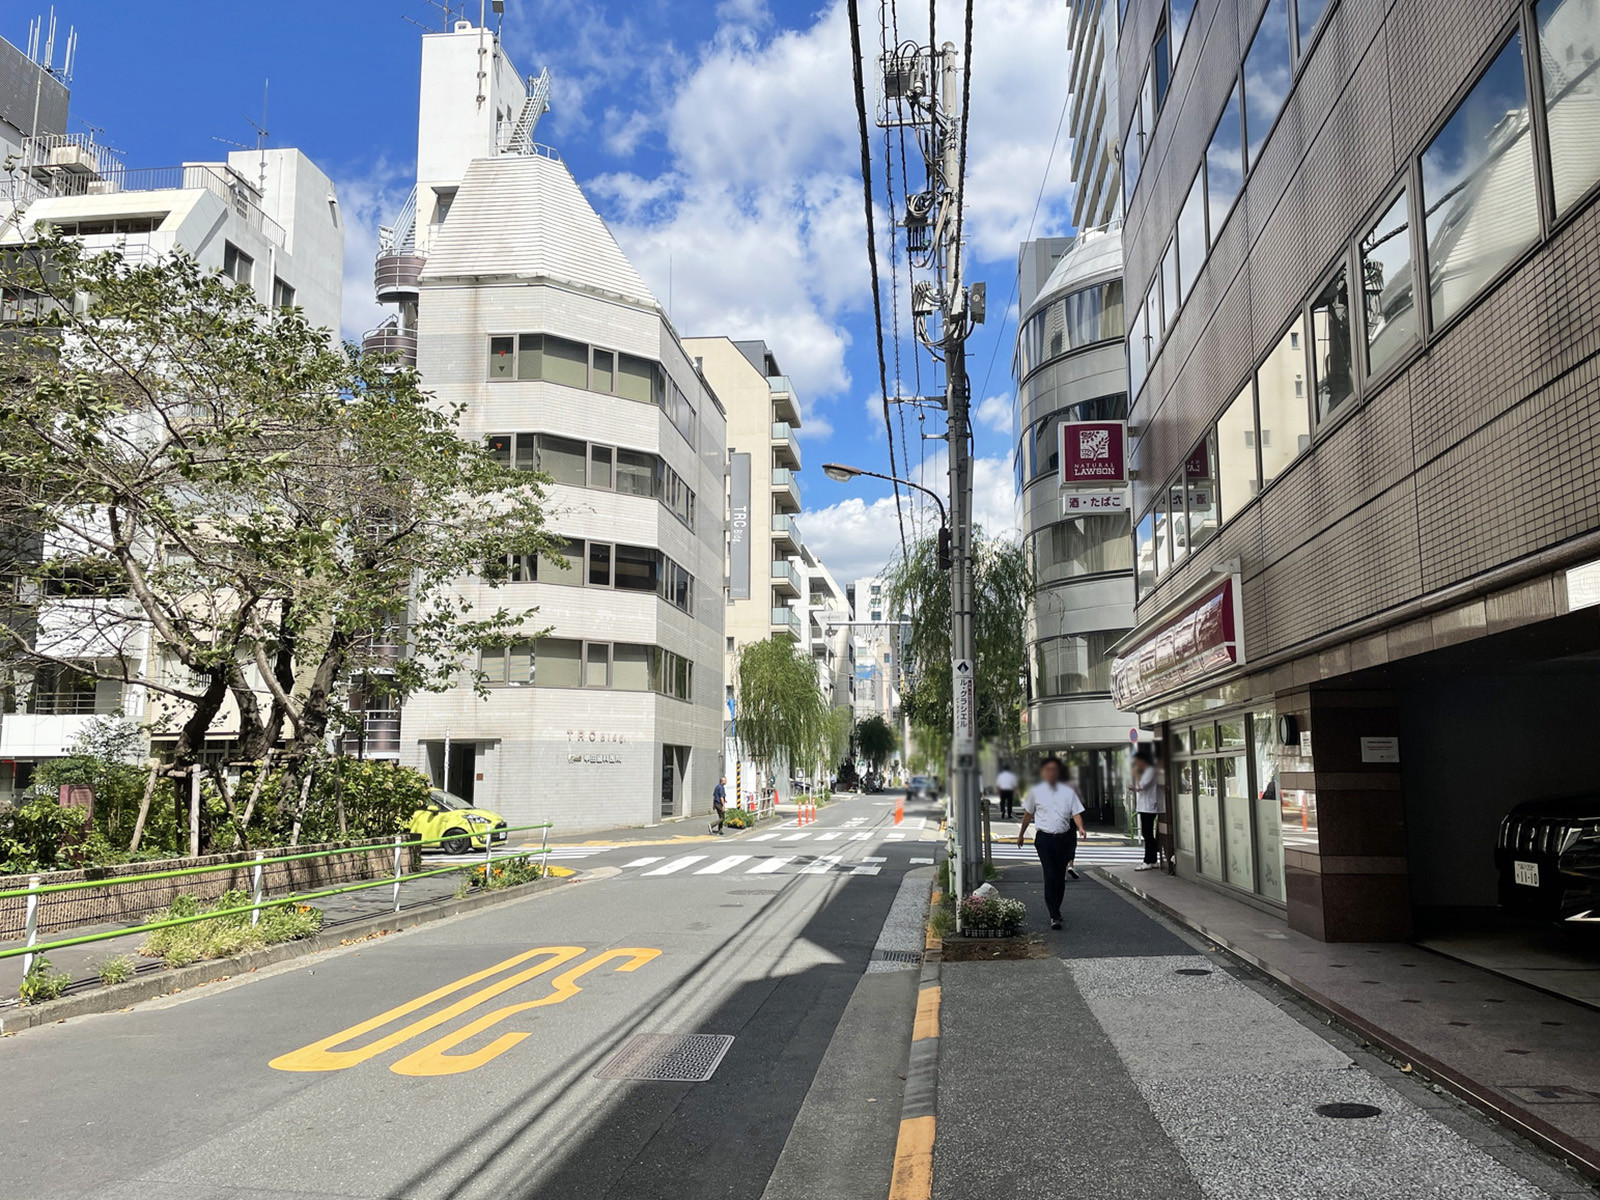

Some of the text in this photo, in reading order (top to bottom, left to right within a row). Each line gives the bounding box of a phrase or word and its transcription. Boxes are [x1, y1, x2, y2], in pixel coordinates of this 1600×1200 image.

[1074, 467, 1115, 476] LAWSON
[1069, 496, 1121, 508] 酒・たばこ
[733, 505, 747, 528] TRC
